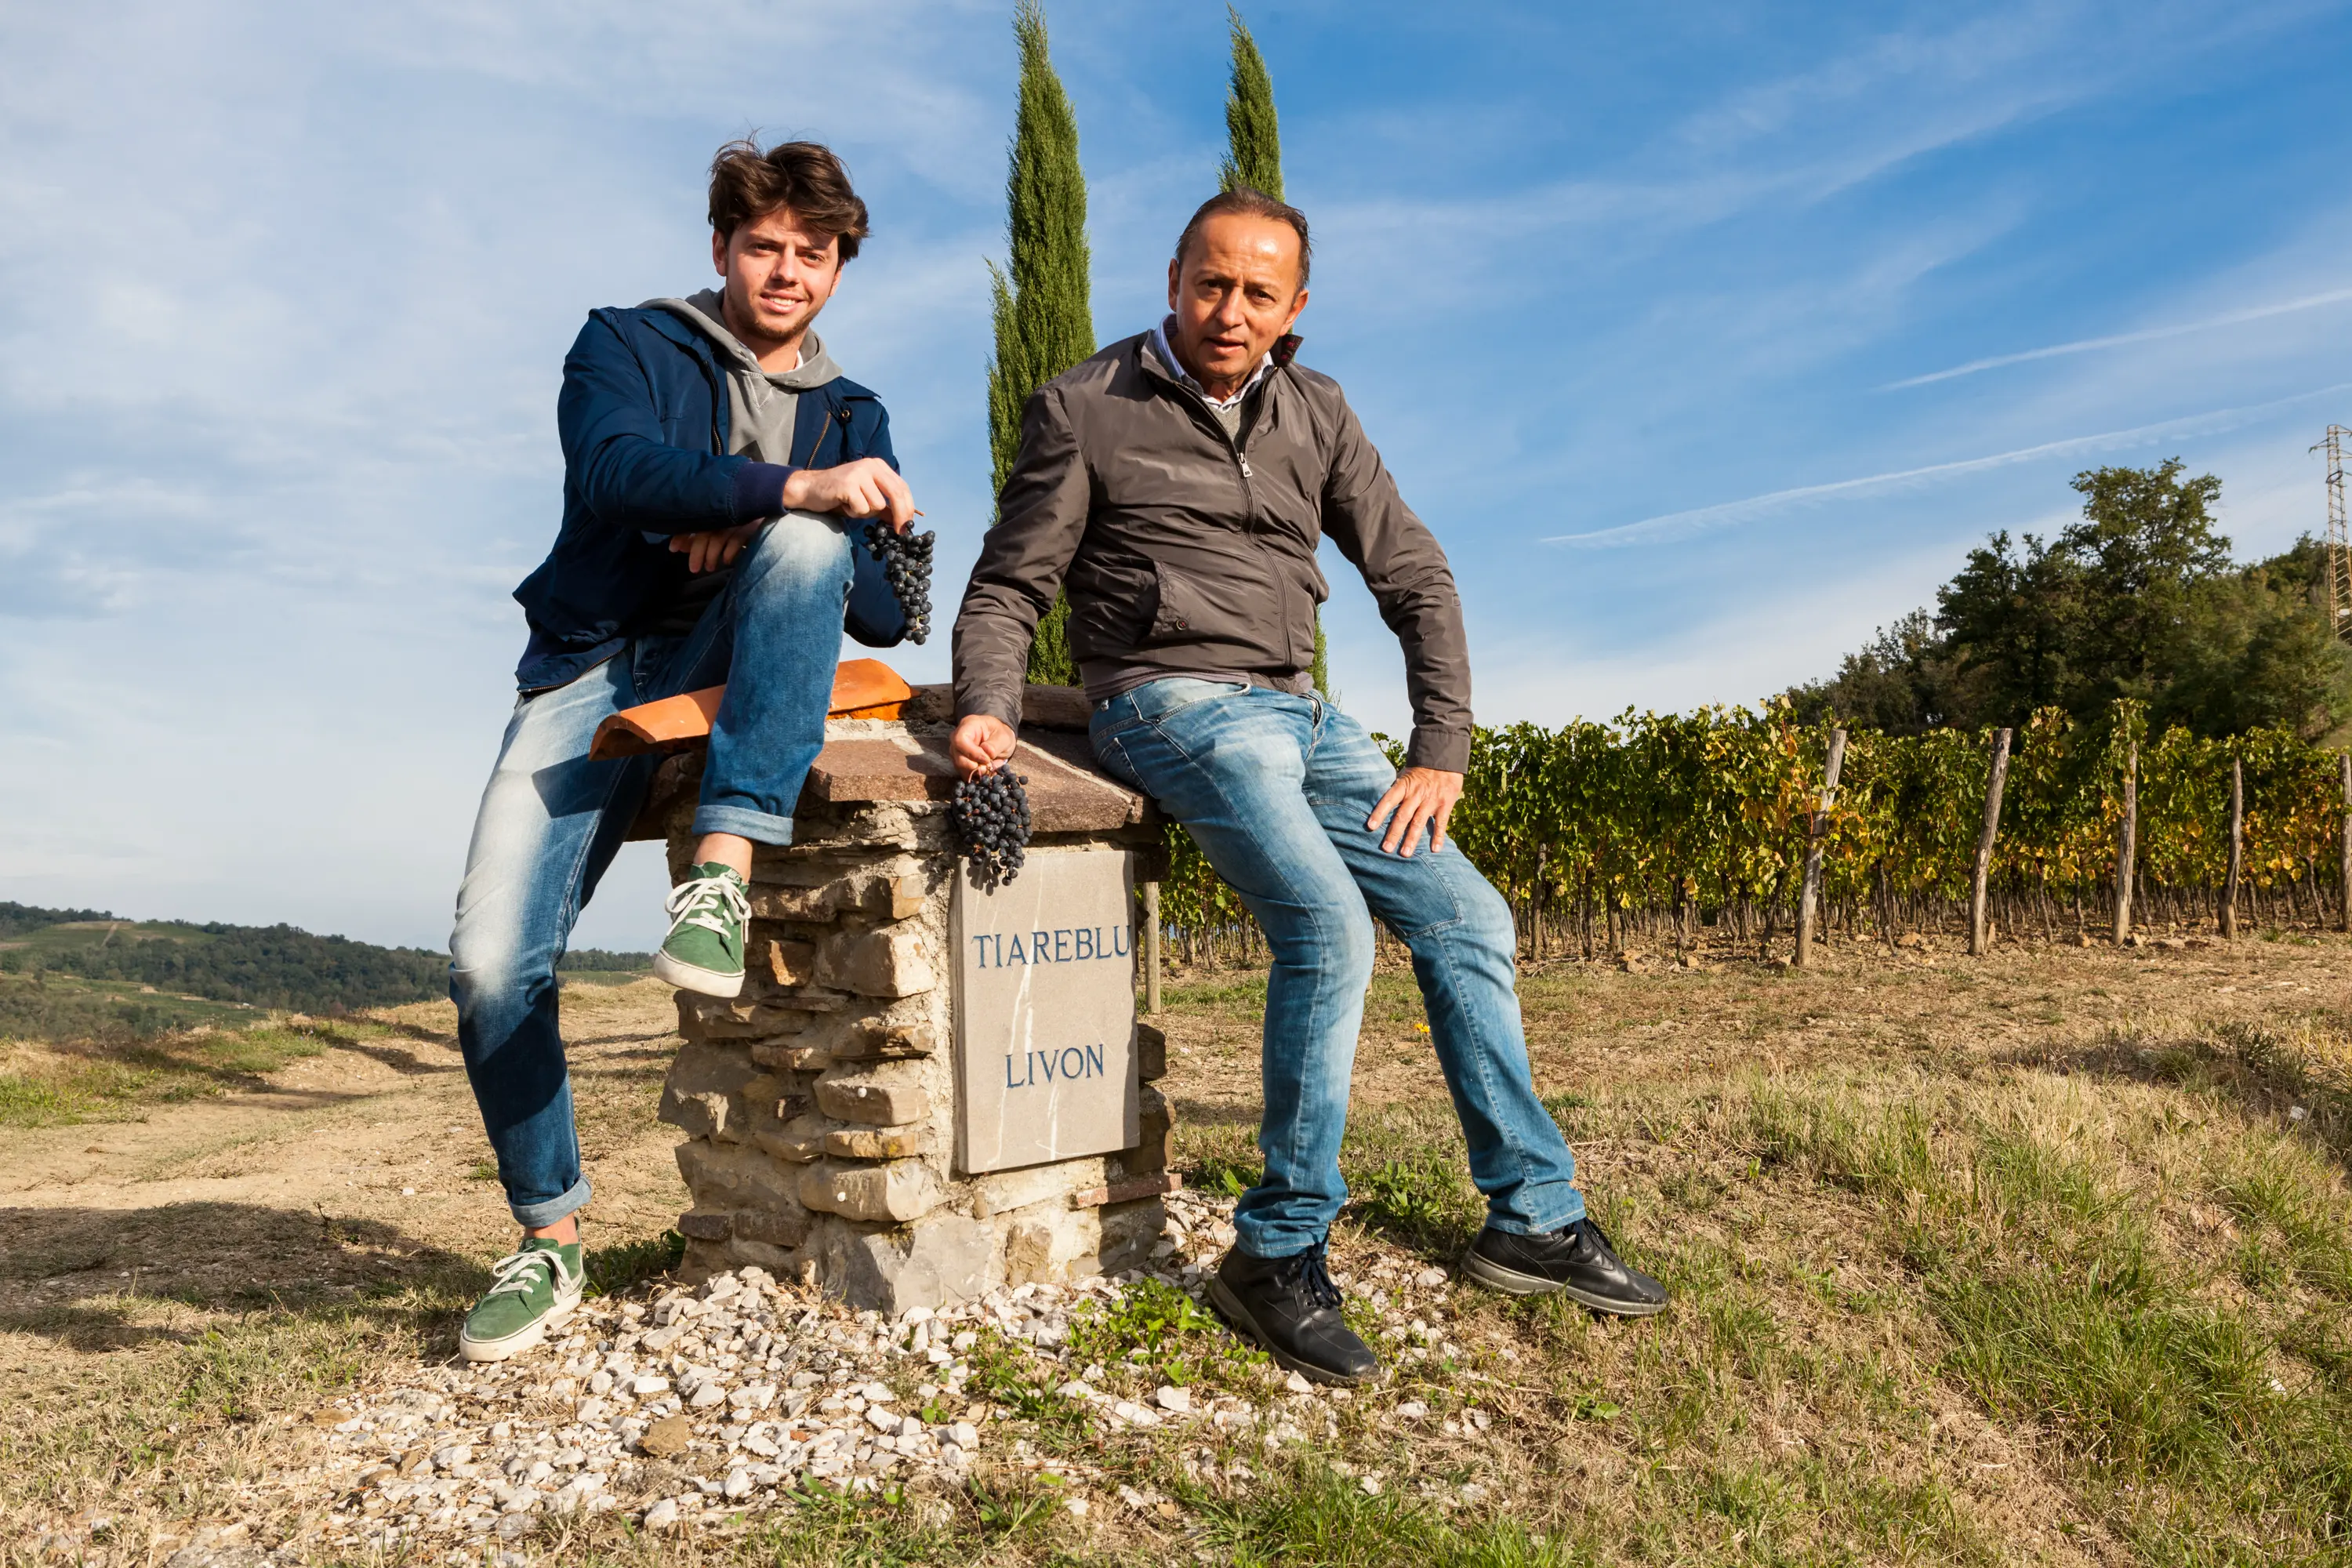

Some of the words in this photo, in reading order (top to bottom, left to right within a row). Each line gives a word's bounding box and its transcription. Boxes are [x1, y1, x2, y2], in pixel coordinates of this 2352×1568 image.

[725, 868, 742, 882] NIKE
[971, 924, 1131, 968] TIAREBLU
[1005, 1044, 1104, 1089] LIVON
